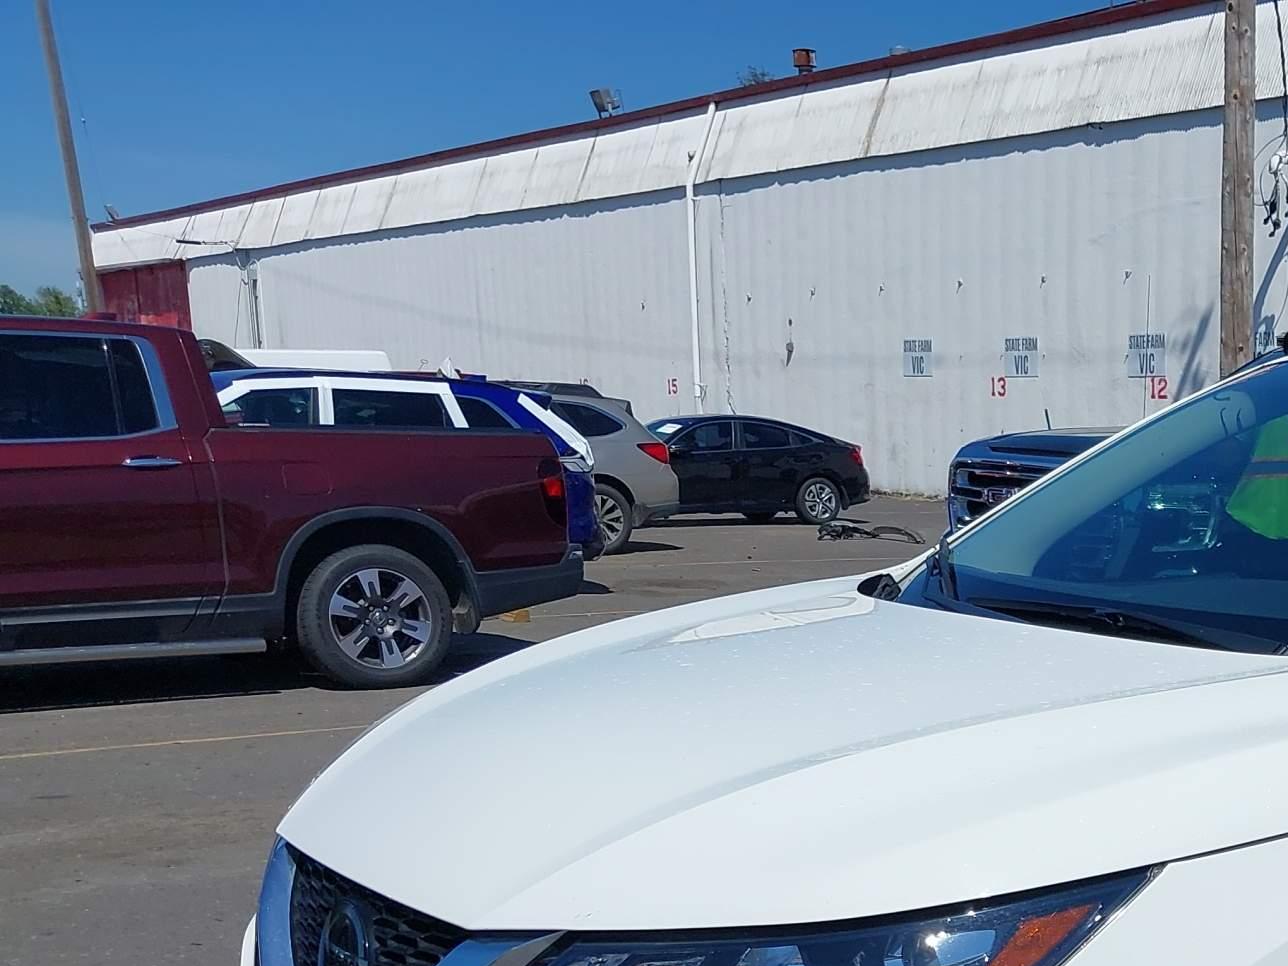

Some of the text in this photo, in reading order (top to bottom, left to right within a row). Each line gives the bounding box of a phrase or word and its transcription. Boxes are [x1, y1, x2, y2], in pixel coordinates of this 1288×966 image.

[903, 339, 932, 353] STATE FARM
[1004, 337, 1038, 353] STATE FARM
[1128, 333, 1166, 350] STATE FARM
[911, 355, 925, 375] VIC
[1013, 354, 1029, 375] VIC
[1138, 352, 1155, 375] VIC
[667, 378, 678, 395] 15
[991, 376, 1006, 397] 13
[1150, 377, 1168, 400] 12
